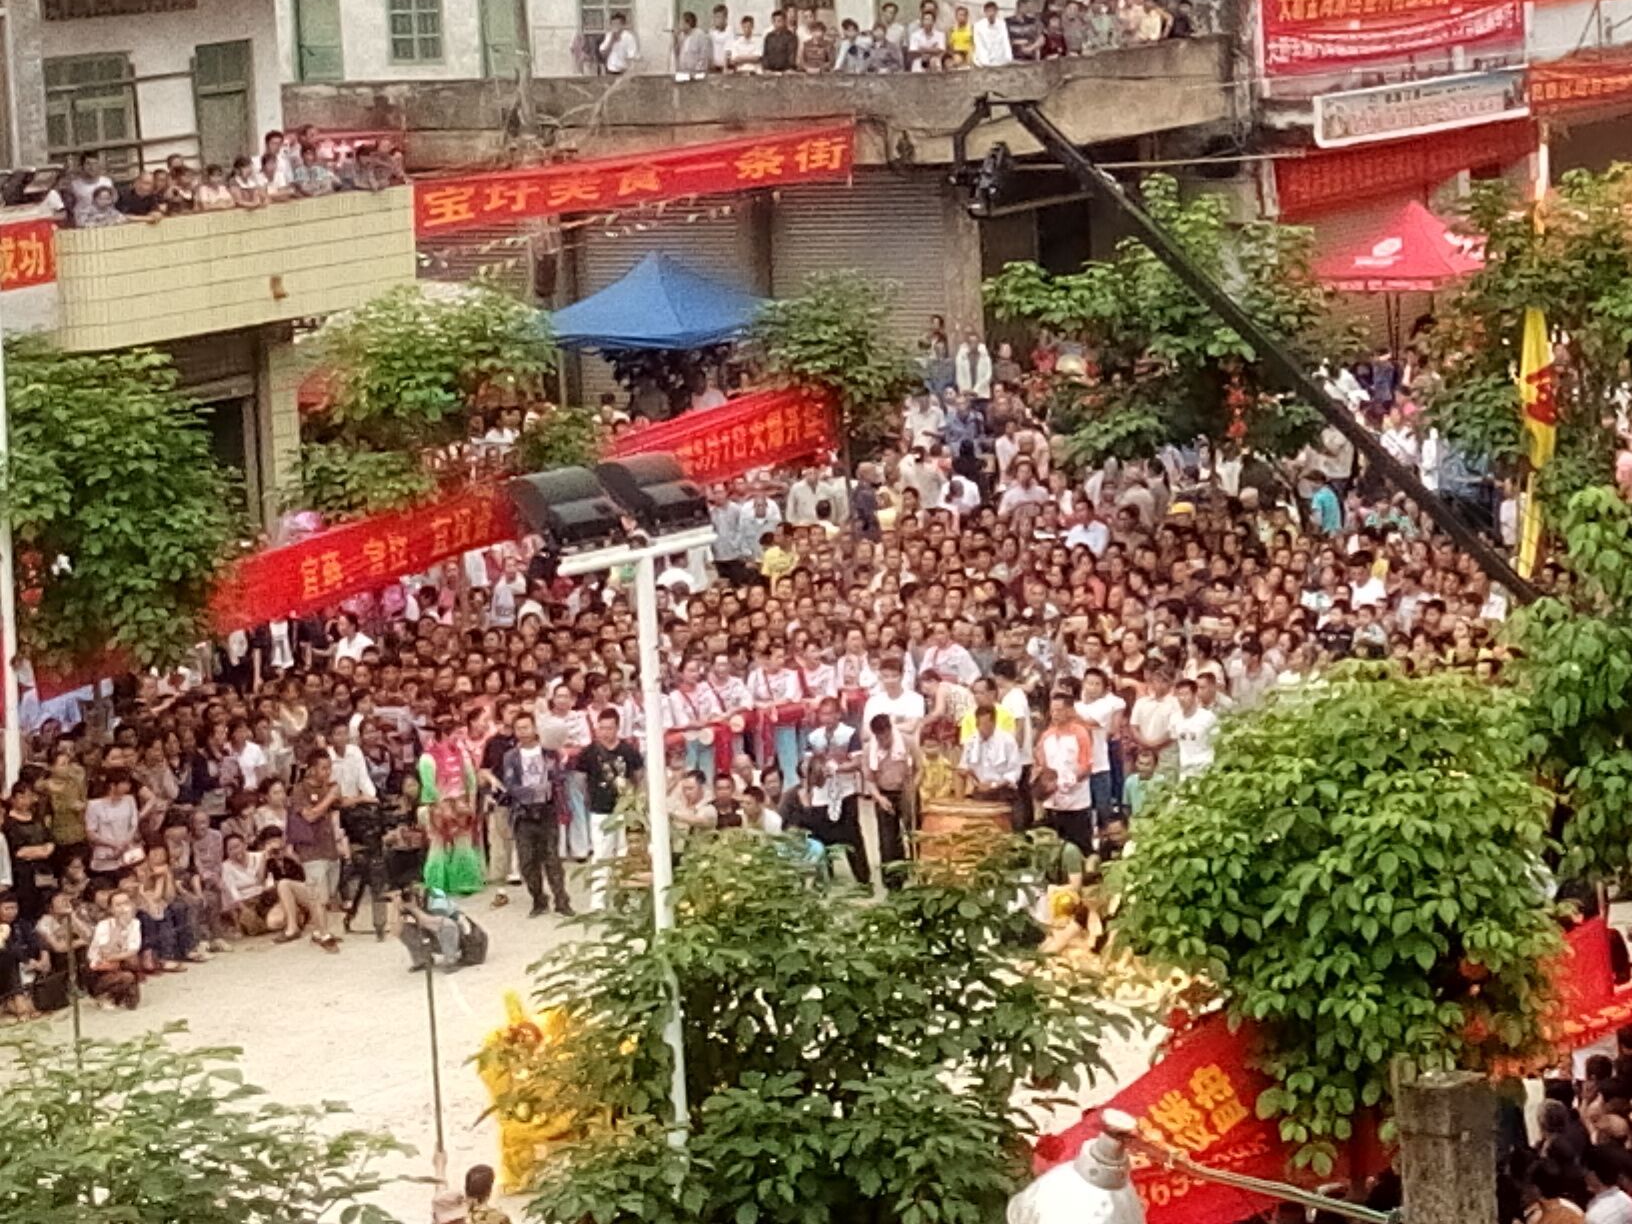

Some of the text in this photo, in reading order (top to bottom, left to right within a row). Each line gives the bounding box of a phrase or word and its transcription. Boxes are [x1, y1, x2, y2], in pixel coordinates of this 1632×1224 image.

[423, 137, 849, 228] 宝圩美食一条街
